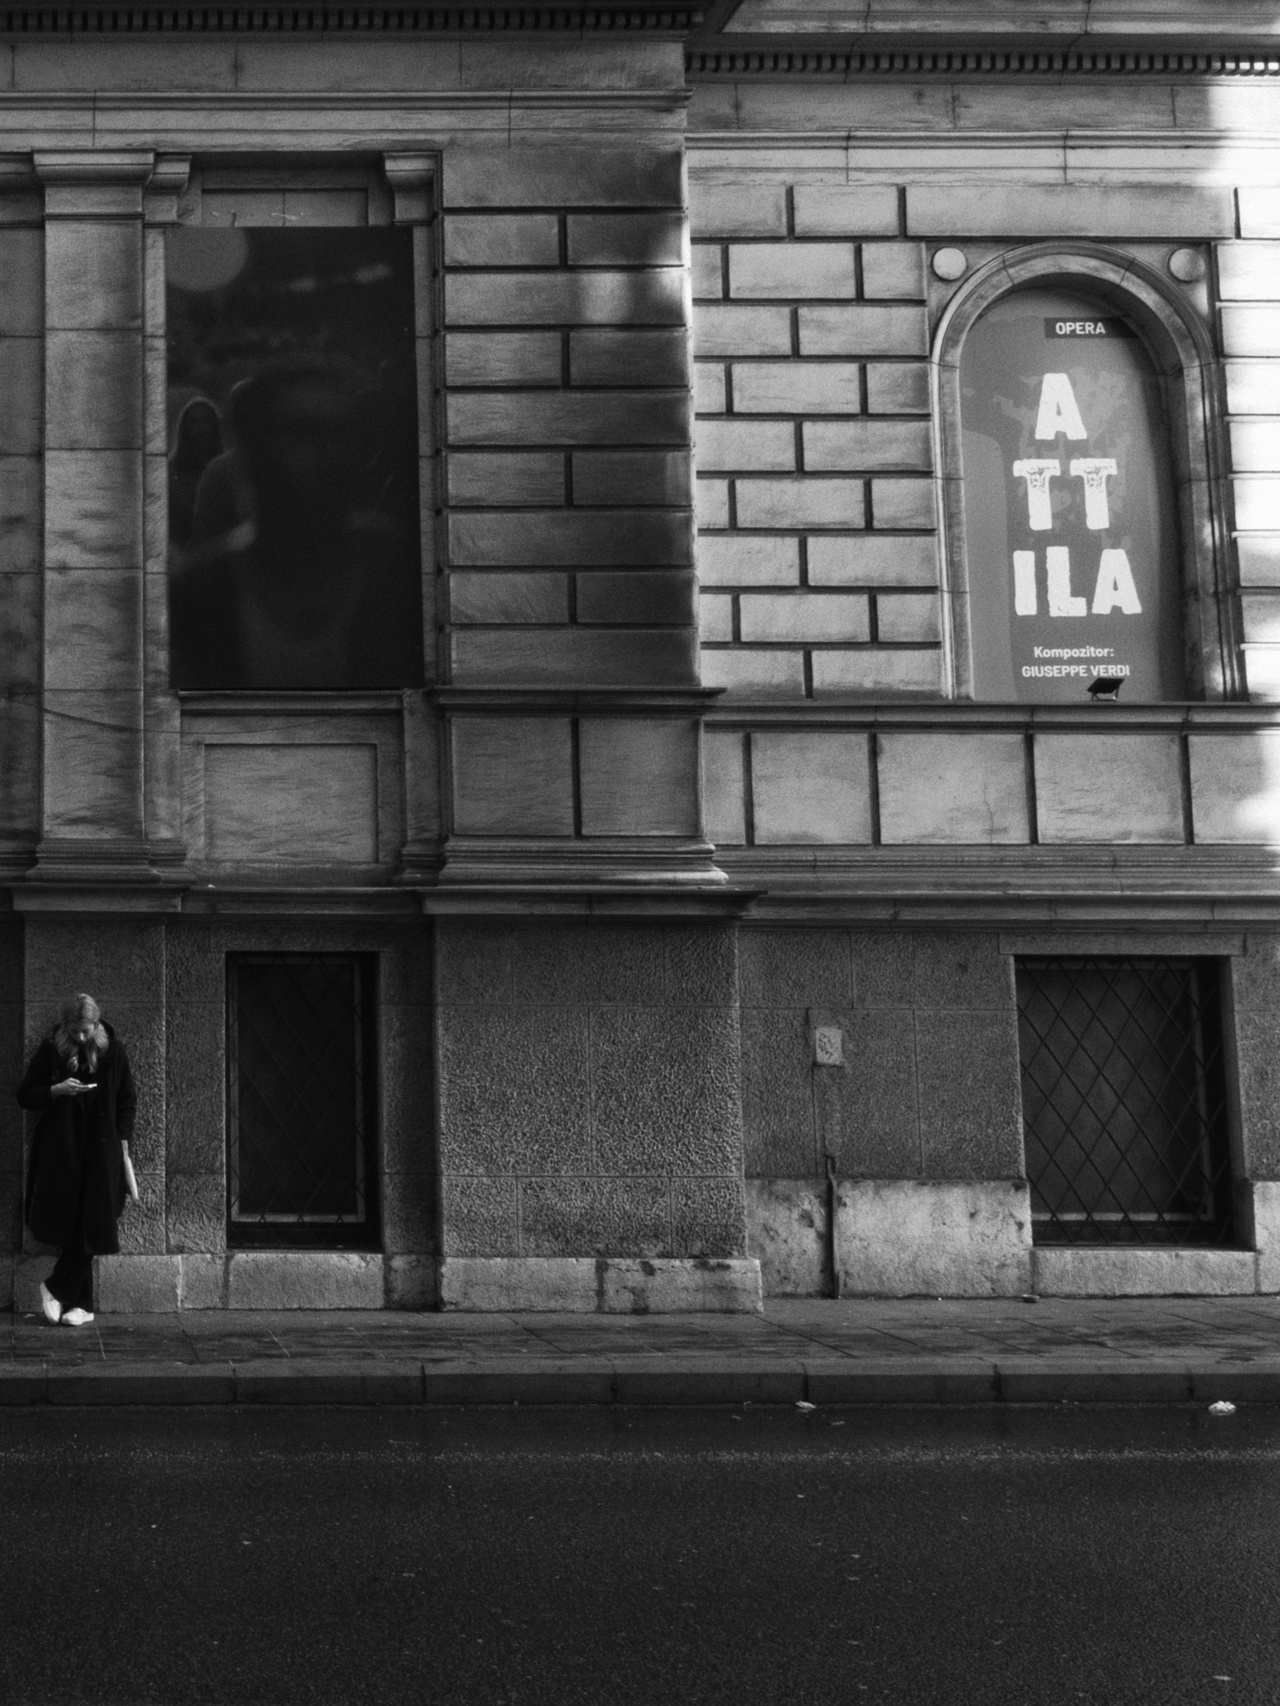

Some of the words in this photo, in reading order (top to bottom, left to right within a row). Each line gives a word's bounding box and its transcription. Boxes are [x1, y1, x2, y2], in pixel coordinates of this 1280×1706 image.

[1055, 322, 1106, 335] OPERA
[1034, 646, 1114, 660] Kompozitor:
[1022, 665, 1088, 677] GIUSEPPE
[1090, 665, 1130, 677] VERDI
